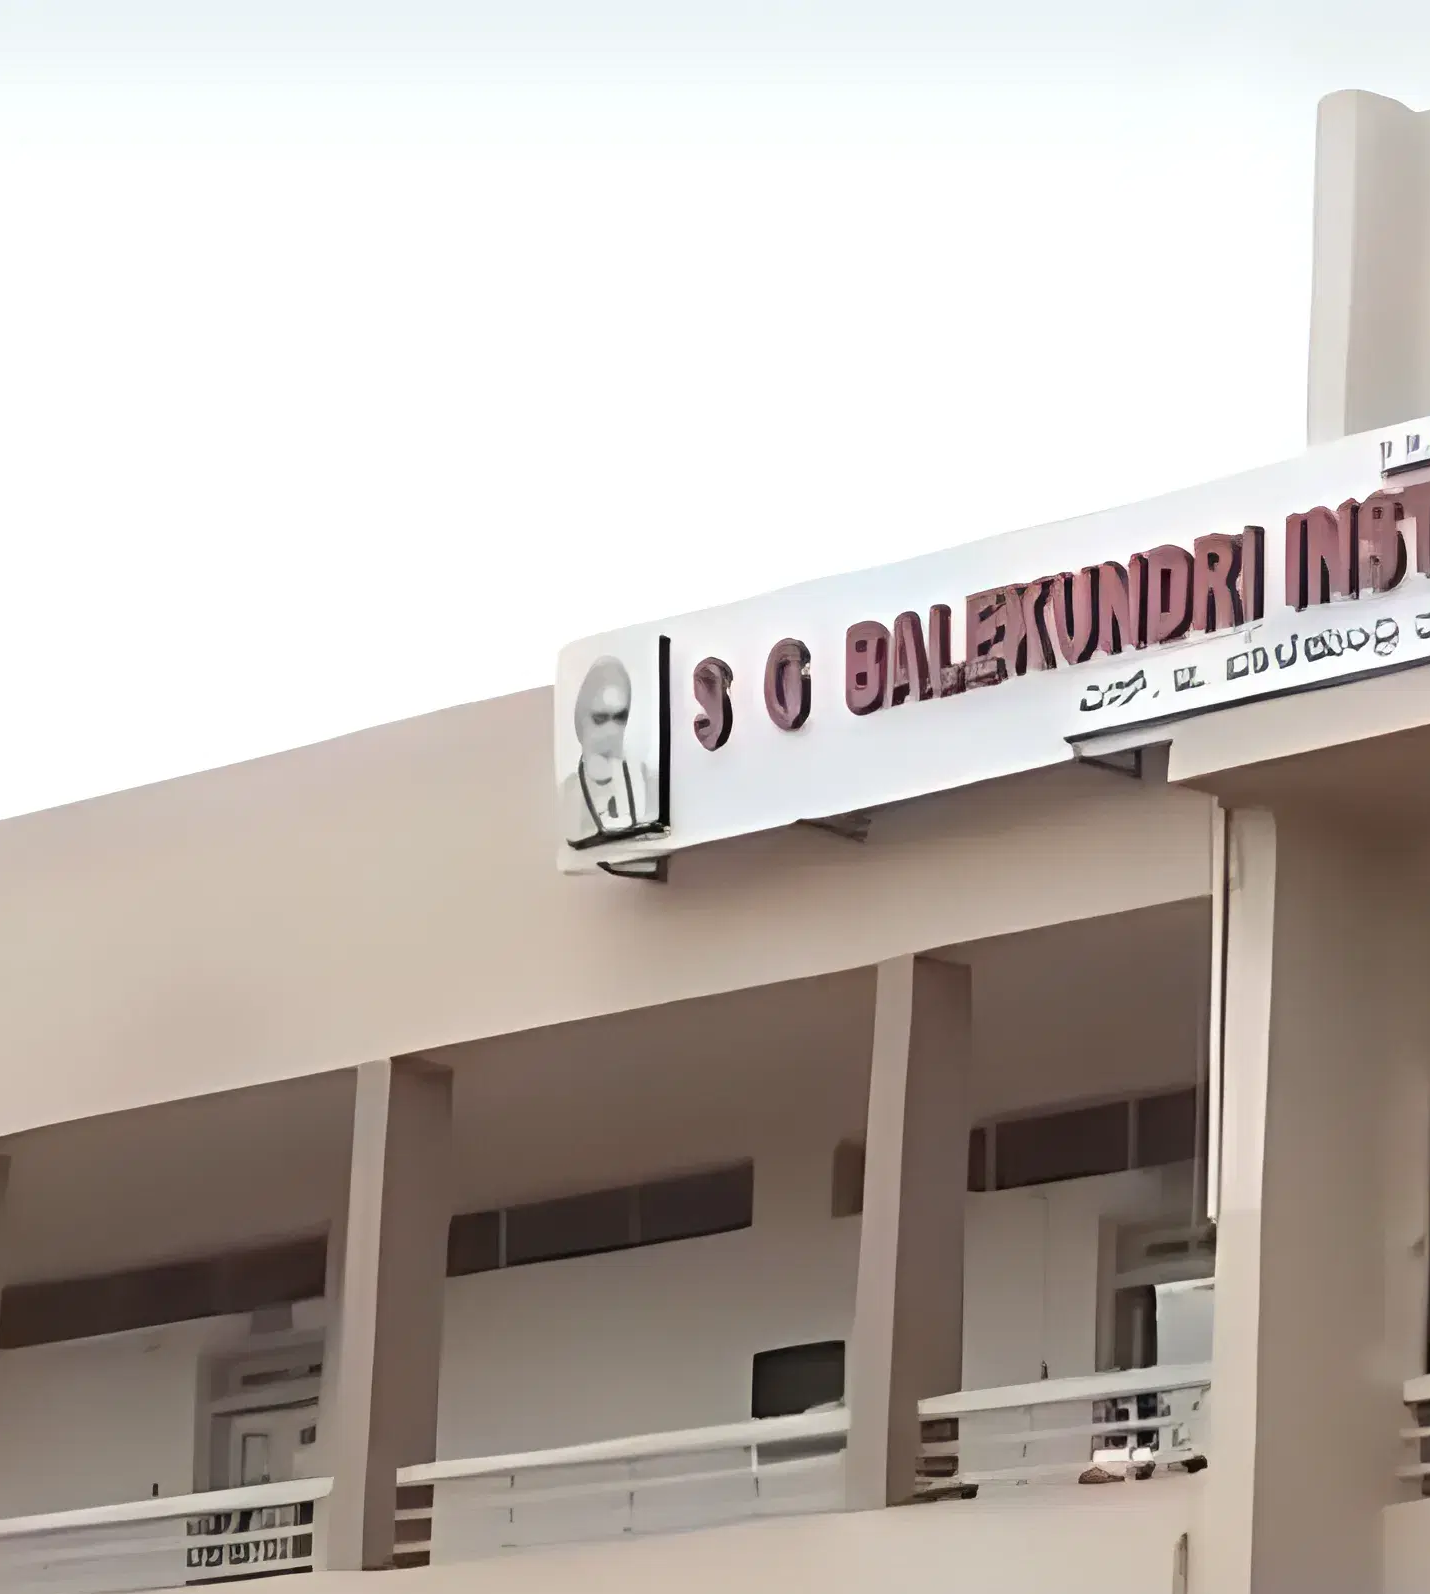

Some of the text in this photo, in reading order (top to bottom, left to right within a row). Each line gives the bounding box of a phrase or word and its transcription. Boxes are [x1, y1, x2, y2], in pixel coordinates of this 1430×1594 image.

[692, 656, 734, 753] S
[763, 636, 812, 734] G
[845, 524, 1266, 717] BALEKUNDRI
